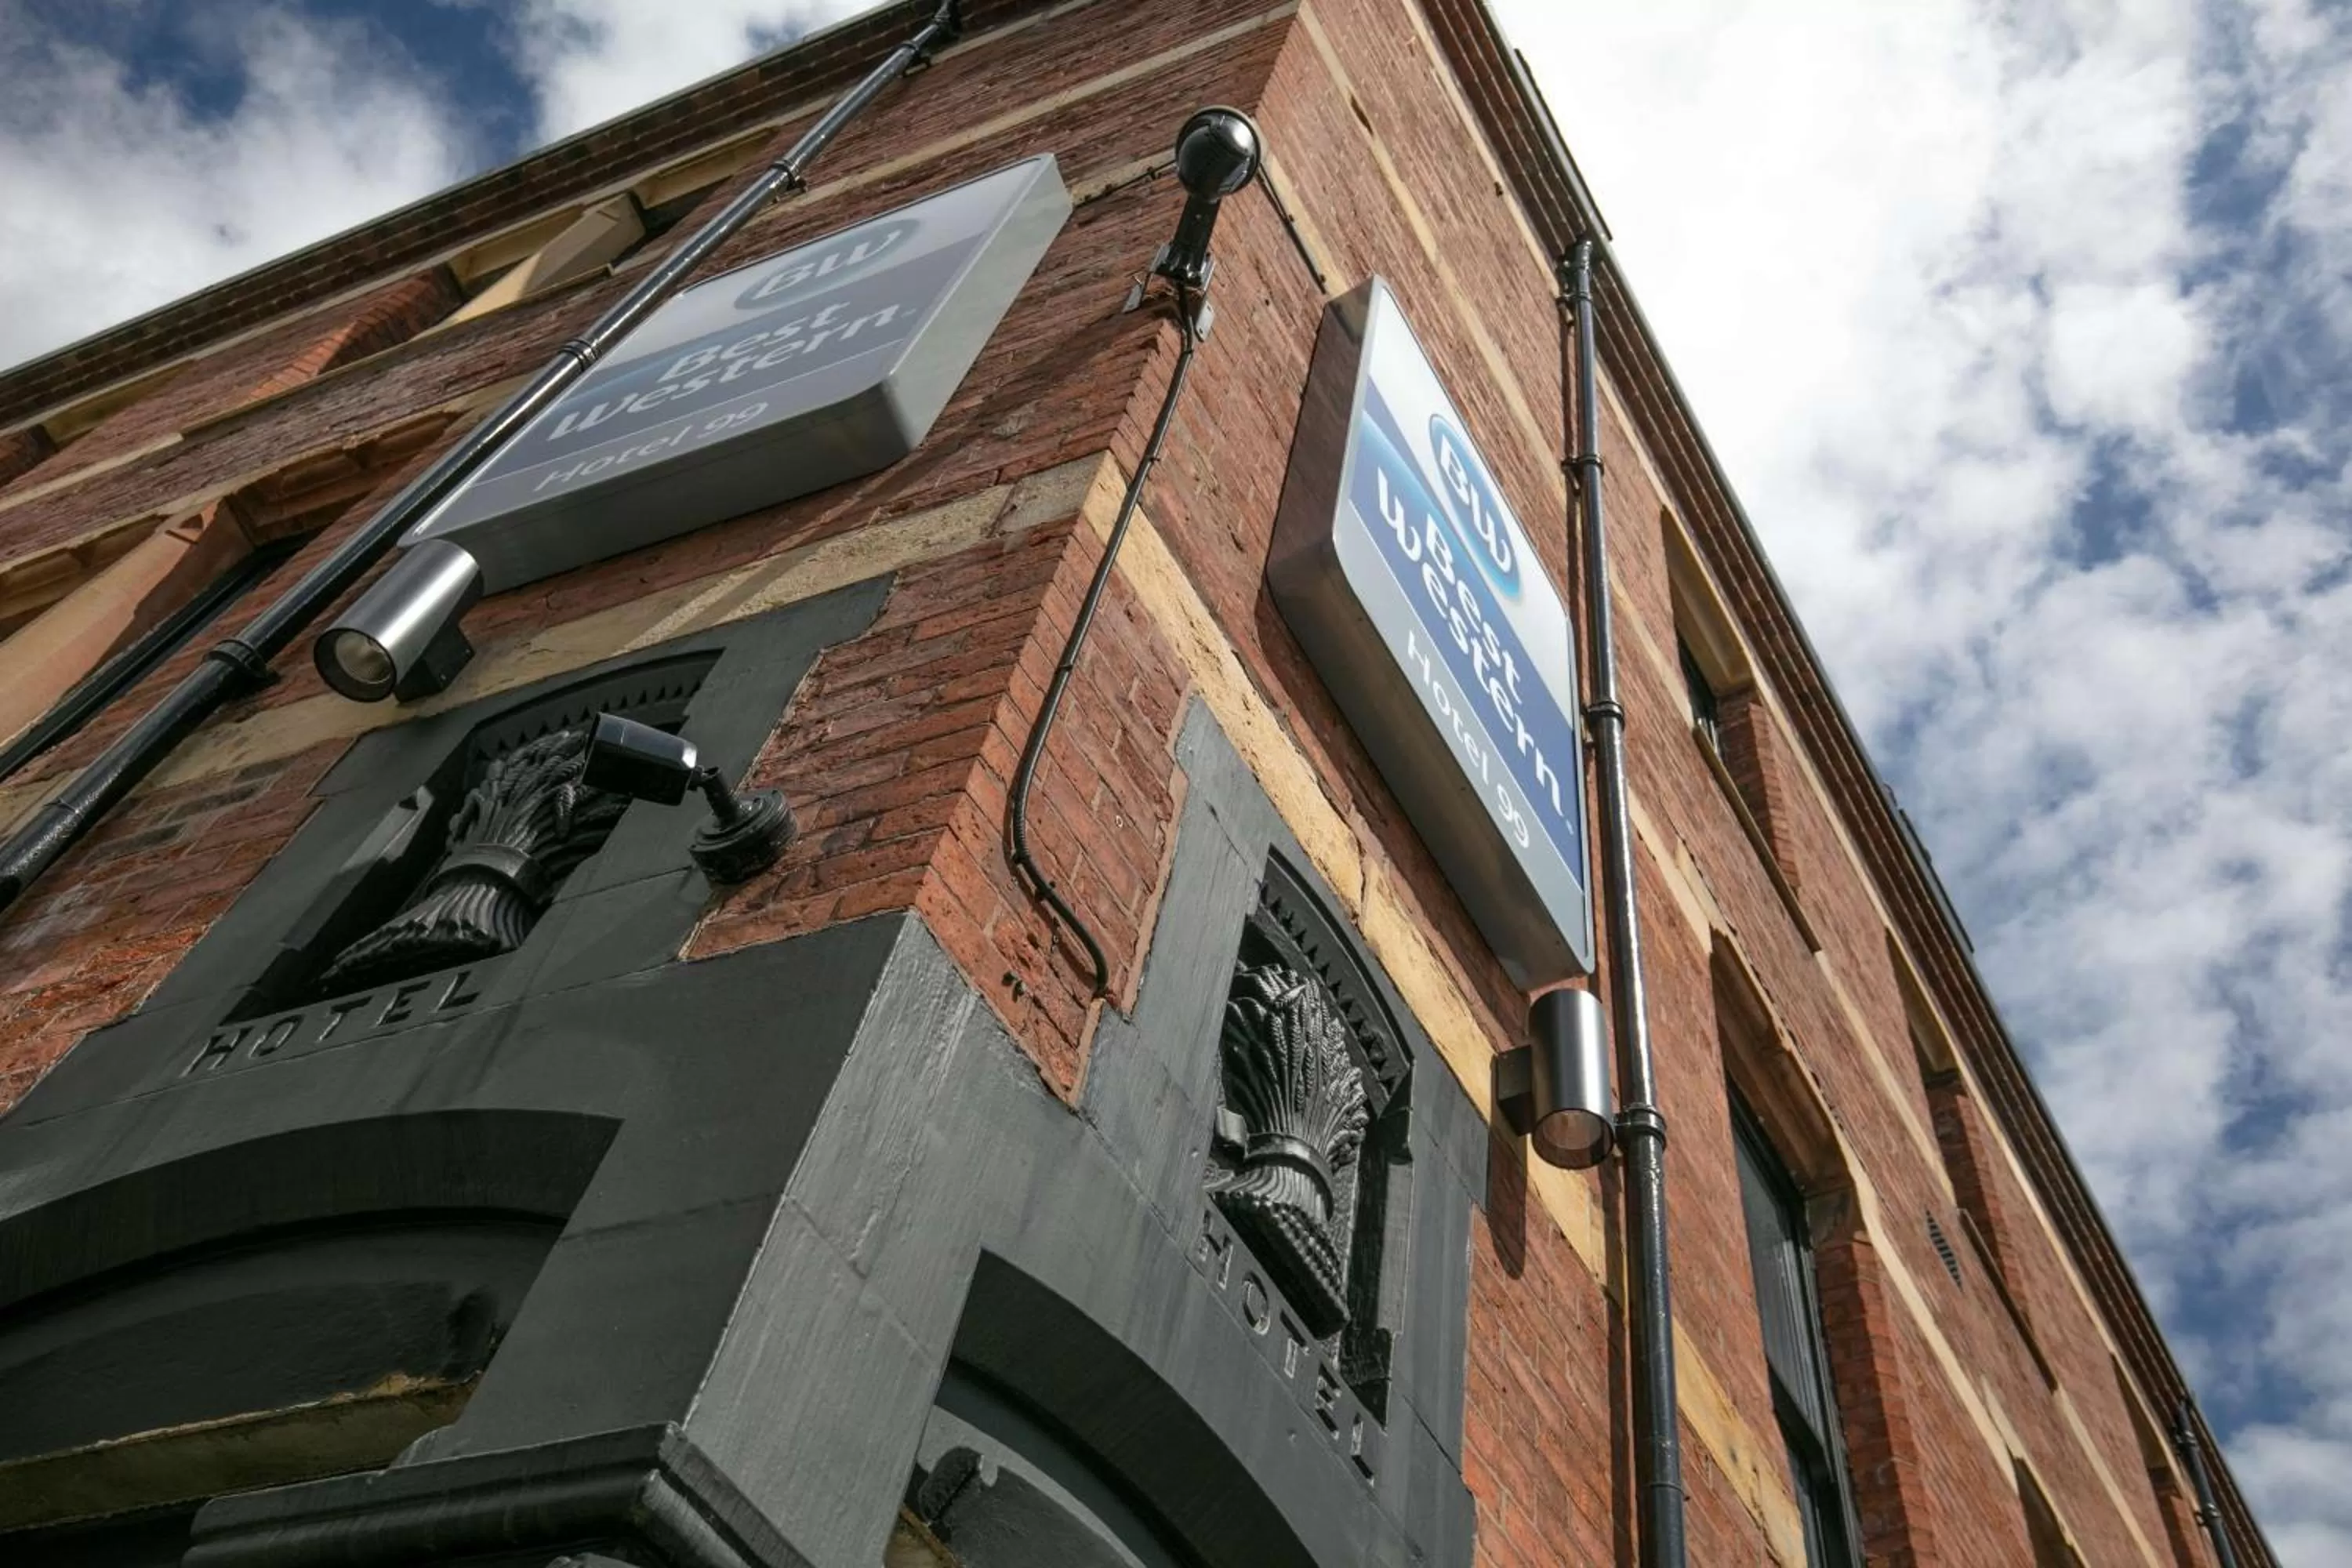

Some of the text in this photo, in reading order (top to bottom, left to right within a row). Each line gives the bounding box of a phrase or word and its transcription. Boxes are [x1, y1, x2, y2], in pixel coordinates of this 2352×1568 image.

[755, 230, 901, 299] BW
[546, 303, 898, 441] Western
[656, 300, 850, 384] Best
[534, 401, 768, 492] Hotel 99
[1439, 431, 1512, 573] BW
[1377, 466, 1565, 817] Western
[1424, 512, 1523, 705] Best
[1407, 630, 1530, 849] Hotel 99
[180, 970, 480, 1077] HOTEL
[1199, 1210, 1375, 1488] HOTEL
